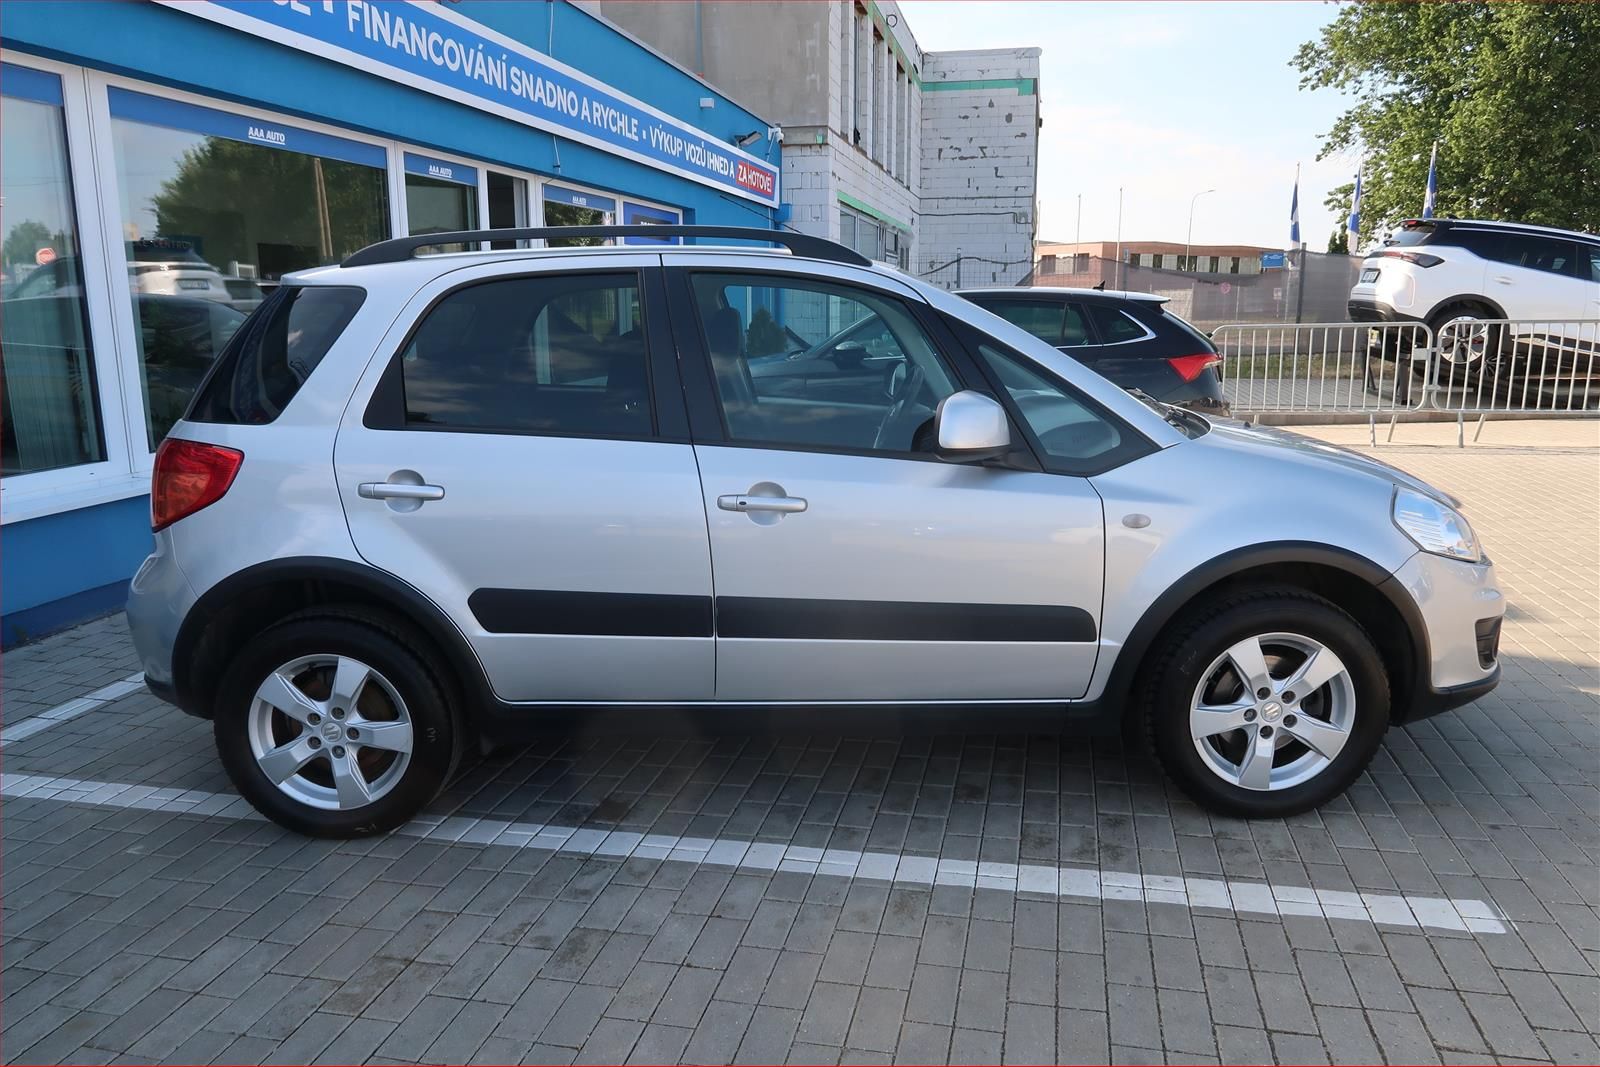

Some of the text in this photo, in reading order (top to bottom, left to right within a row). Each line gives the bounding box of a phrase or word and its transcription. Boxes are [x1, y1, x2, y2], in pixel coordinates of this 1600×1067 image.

[248, 126, 286, 143] AAA AUTO
[347, 0, 507, 91] FINANCOVÁNÍ
[510, 66, 579, 117] SNADNO
[581, 97, 591, 123] A
[592, 101, 639, 141] RYCHLE
[649, 124, 683, 157] VÝKUP
[707, 151, 729, 175] IHNED
[729, 161, 735, 179] A
[738, 165, 747, 183] ZA
